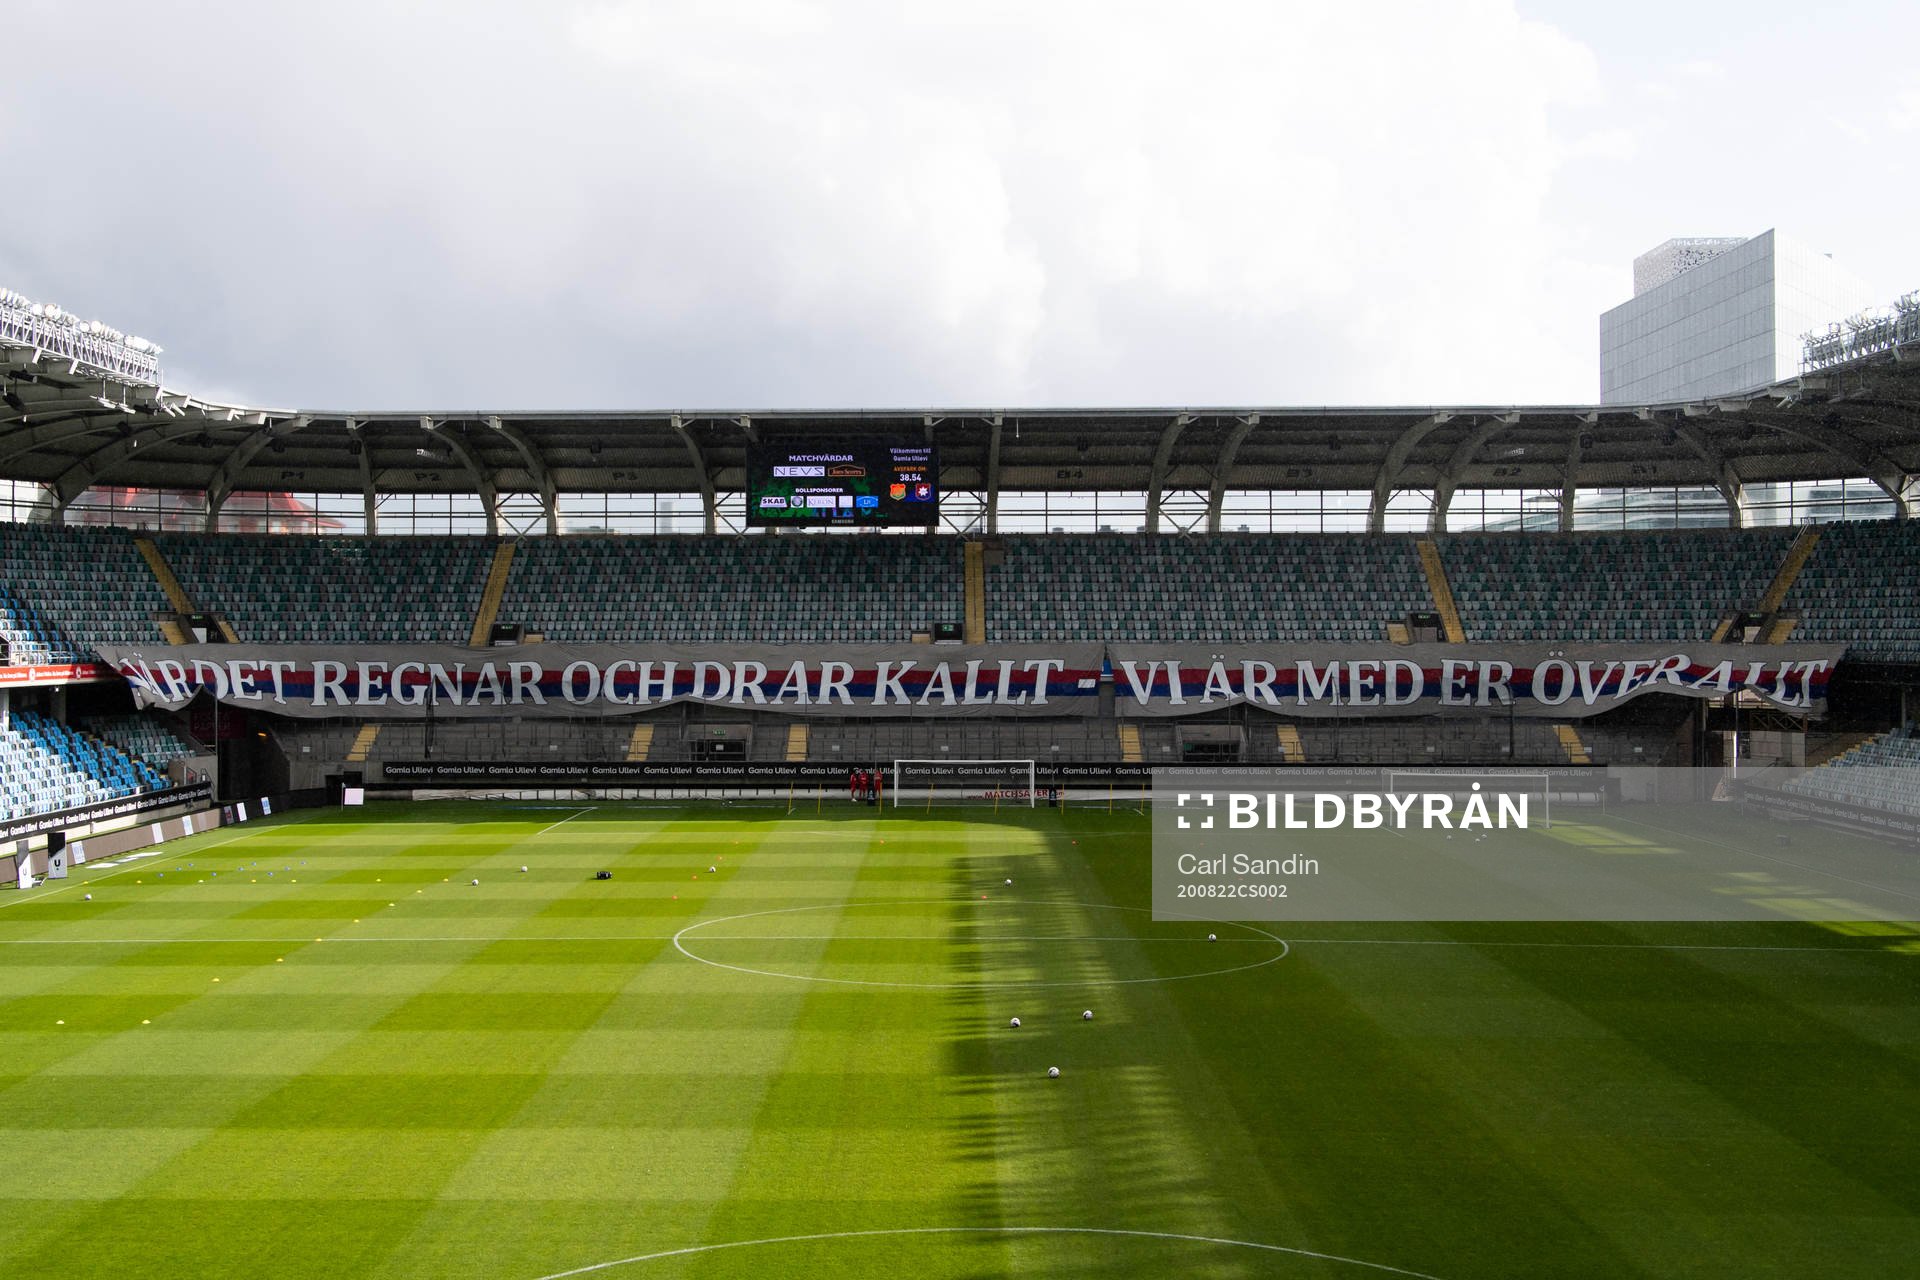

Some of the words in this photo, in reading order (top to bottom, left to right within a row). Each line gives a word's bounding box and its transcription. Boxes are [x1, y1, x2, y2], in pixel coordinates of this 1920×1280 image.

[281, 471, 304, 480] P1
[775, 468, 824, 476] NEVS
[311, 660, 548, 706] REGNAR
[560, 659, 680, 706] OCH
[688, 659, 856, 706] DRAR
[871, 658, 1065, 706] KALLT
[1119, 660, 1188, 706] VI
[1199, 653, 1282, 706] ÄR
[1295, 660, 1425, 707] MED
[1438, 658, 1516, 707] ER
[1543, 768, 1568, 776] Gamla
[1570, 768, 1592, 776] Ullevi
[10, 826, 25, 836] Gamla
[39, 820, 53, 830] Gamla
[66, 816, 79, 824] Gamla
[91, 810, 104, 818] Gamla
